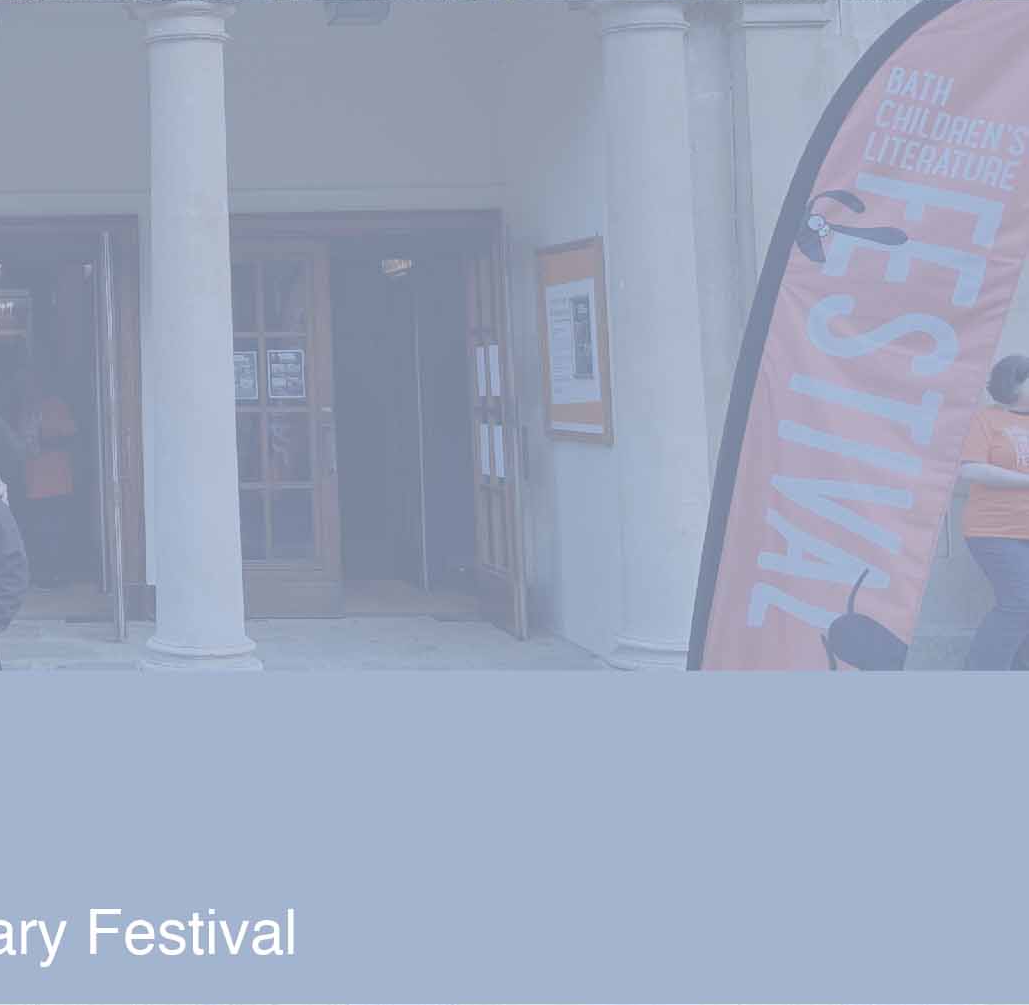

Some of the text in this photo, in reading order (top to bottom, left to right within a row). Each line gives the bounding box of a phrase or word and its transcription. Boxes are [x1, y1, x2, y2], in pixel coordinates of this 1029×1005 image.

[886, 67, 955, 107] BATH
[874, 99, 1027, 156] CHILDREN'S
[864, 131, 1019, 191] LITERATURE
[746, 171, 1004, 628] FESTIVAL
